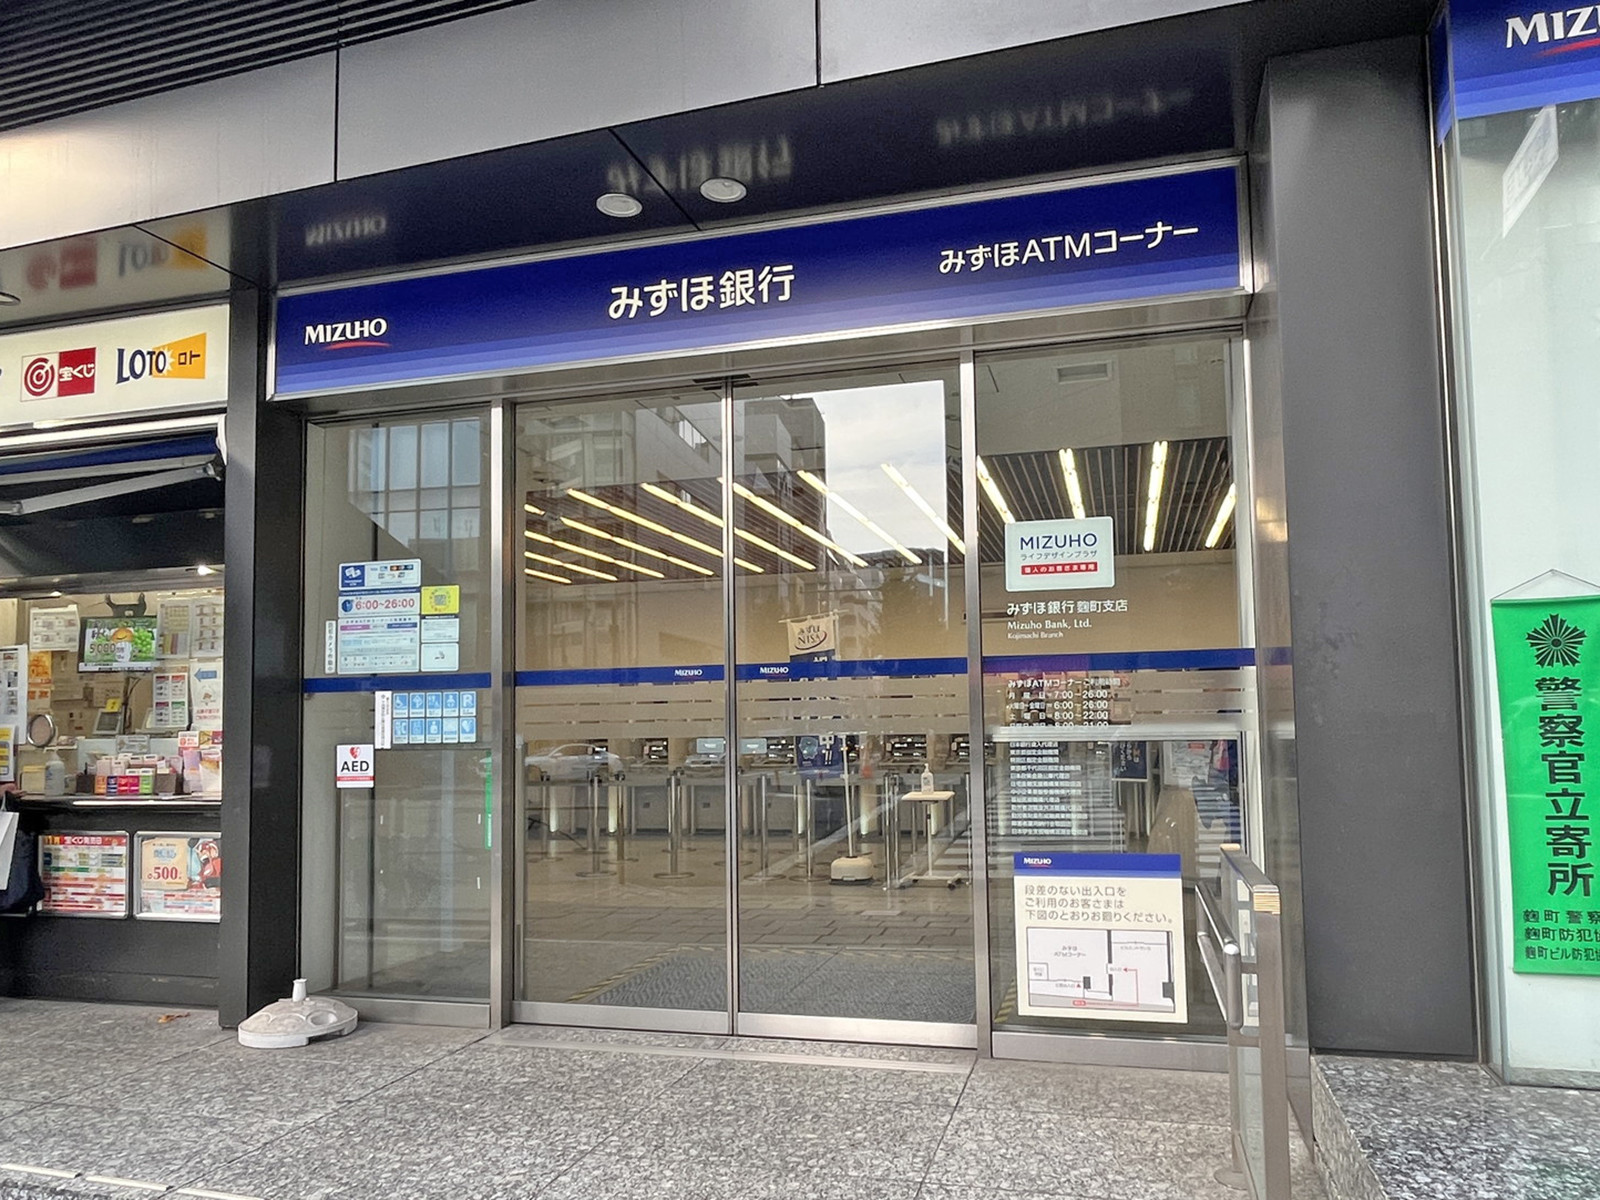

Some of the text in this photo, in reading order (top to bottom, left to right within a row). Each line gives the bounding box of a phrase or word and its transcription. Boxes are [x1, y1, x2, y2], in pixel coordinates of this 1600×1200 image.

[1506, 5, 1600, 48] MIZ
[938, 221, 1199, 274] みずほATMコーナー
[607, 264, 796, 320] みずほ銀行
[303, 317, 389, 346] MIZUHO
[59, 363, 95, 382] 宝くじ
[116, 348, 167, 384] LOTO
[1020, 533, 1098, 551] MIZUHO
[1021, 550, 1098, 561] ライフデザインプラザ
[1024, 563, 1096, 574] 個人のお客さま専用
[1006, 600, 1075, 616] みずほ銀行
[1007, 618, 1092, 630] Mizuho Bank, Ltd.
[1007, 631, 1064, 640] Kojimachi Branch
[674, 669, 703, 677] MIZUHO
[760, 667, 789, 675] MIZUHO
[341, 761, 370, 773] AED
[1534, 676, 1594, 897] 警察官立寄所
[1023, 857, 1052, 866] MIZUHO
[153, 866, 179, 881] 500
[1025, 885, 1127, 897] 段差のない出入口を
[1025, 897, 1125, 910] ご利用のお客さまは
[1026, 909, 1173, 924] 下図のとおりお廻りください。
